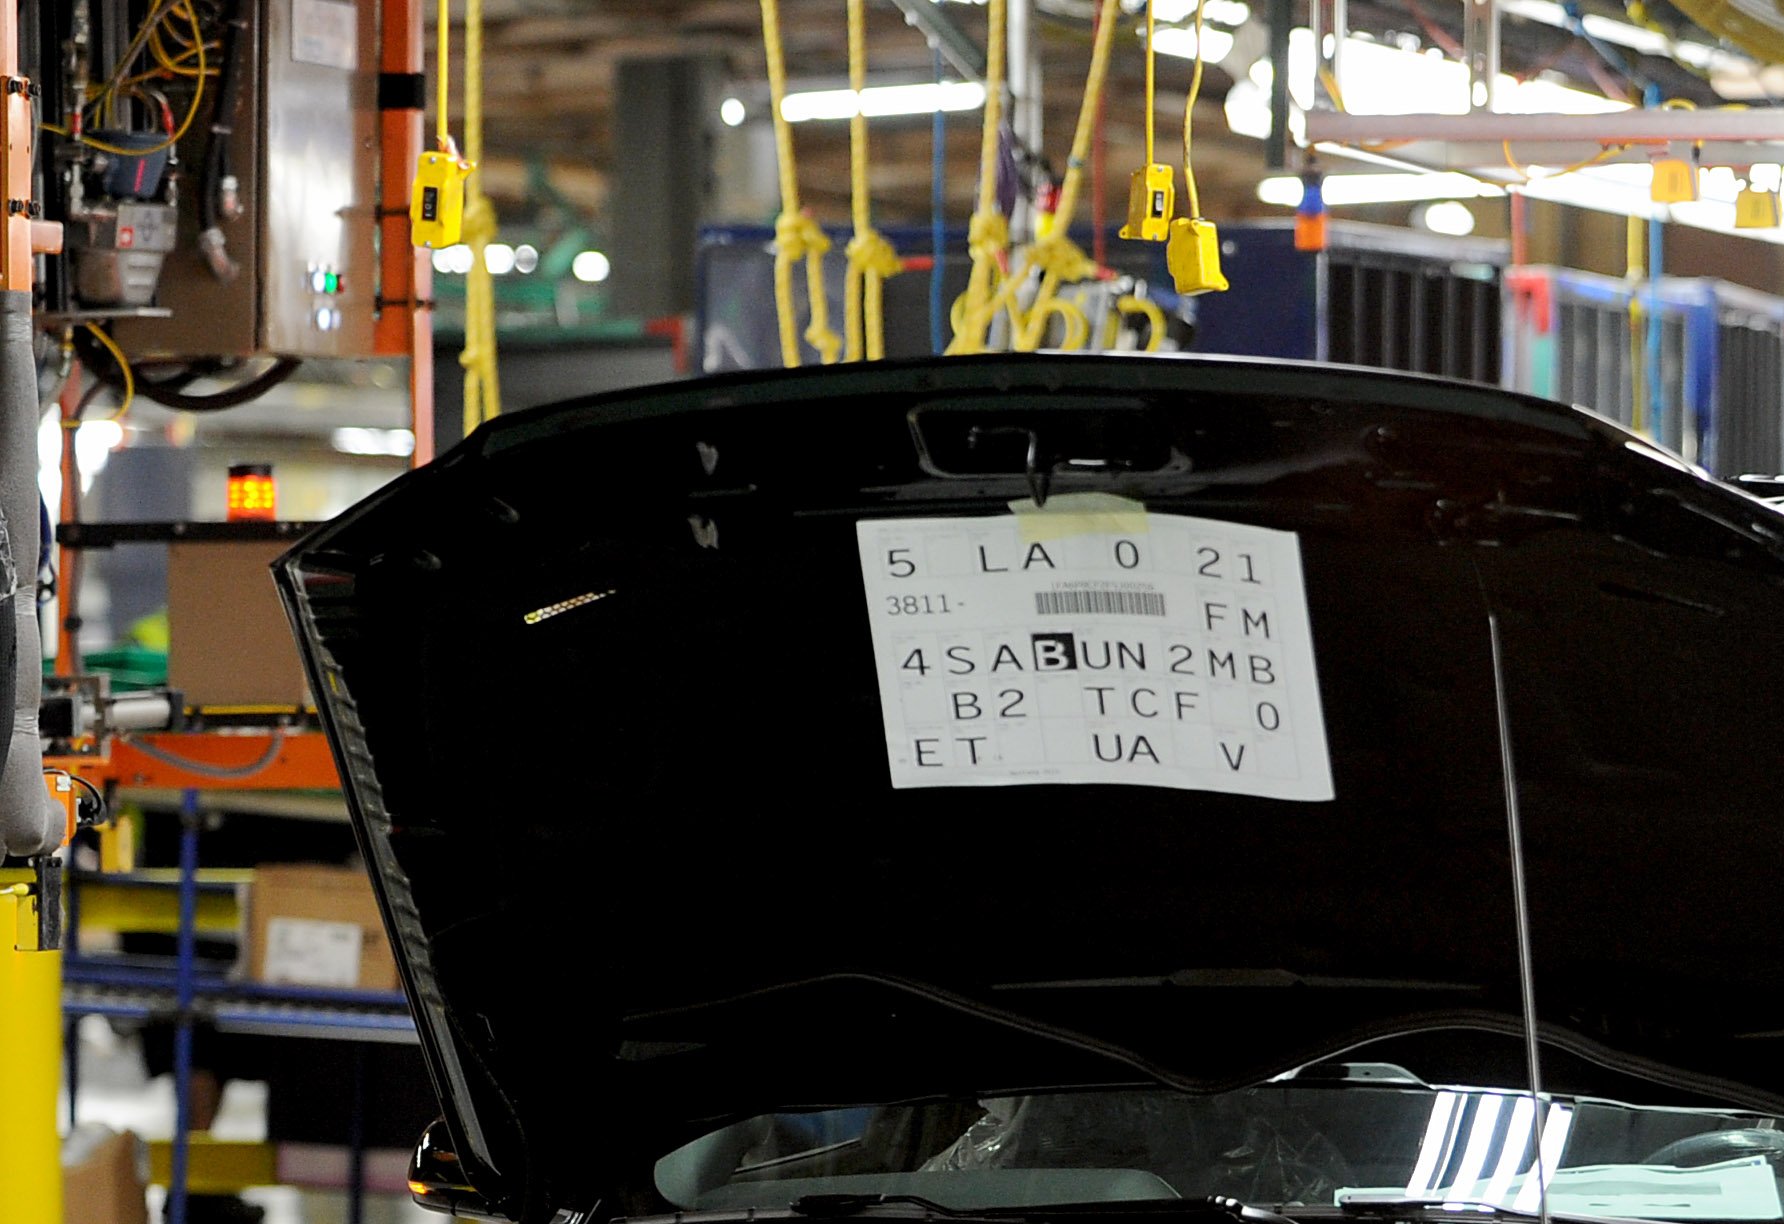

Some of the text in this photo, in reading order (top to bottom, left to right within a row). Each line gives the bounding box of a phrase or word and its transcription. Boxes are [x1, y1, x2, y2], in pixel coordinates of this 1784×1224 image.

[888, 549, 915, 578] 5
[1093, 734, 1160, 764] UA
[1220, 743, 1244, 771] V
